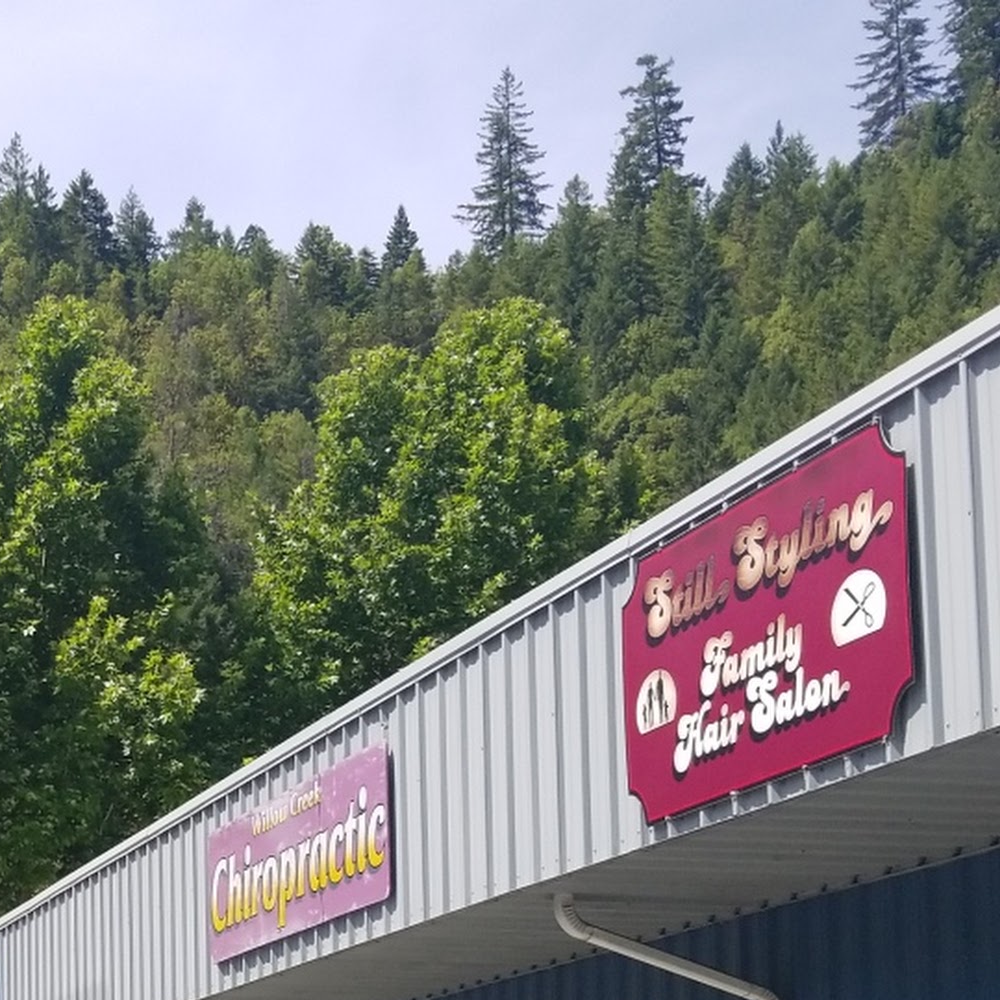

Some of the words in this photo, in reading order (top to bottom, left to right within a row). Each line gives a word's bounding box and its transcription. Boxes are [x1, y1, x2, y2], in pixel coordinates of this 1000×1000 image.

[643, 555, 730, 638] Still
[735, 488, 894, 591] Styling
[699, 612, 804, 698] Family
[673, 700, 746, 774] Hair
[746, 667, 851, 734] Salon
[289, 780, 322, 816] Creek
[211, 786, 385, 934] Chiropractic
